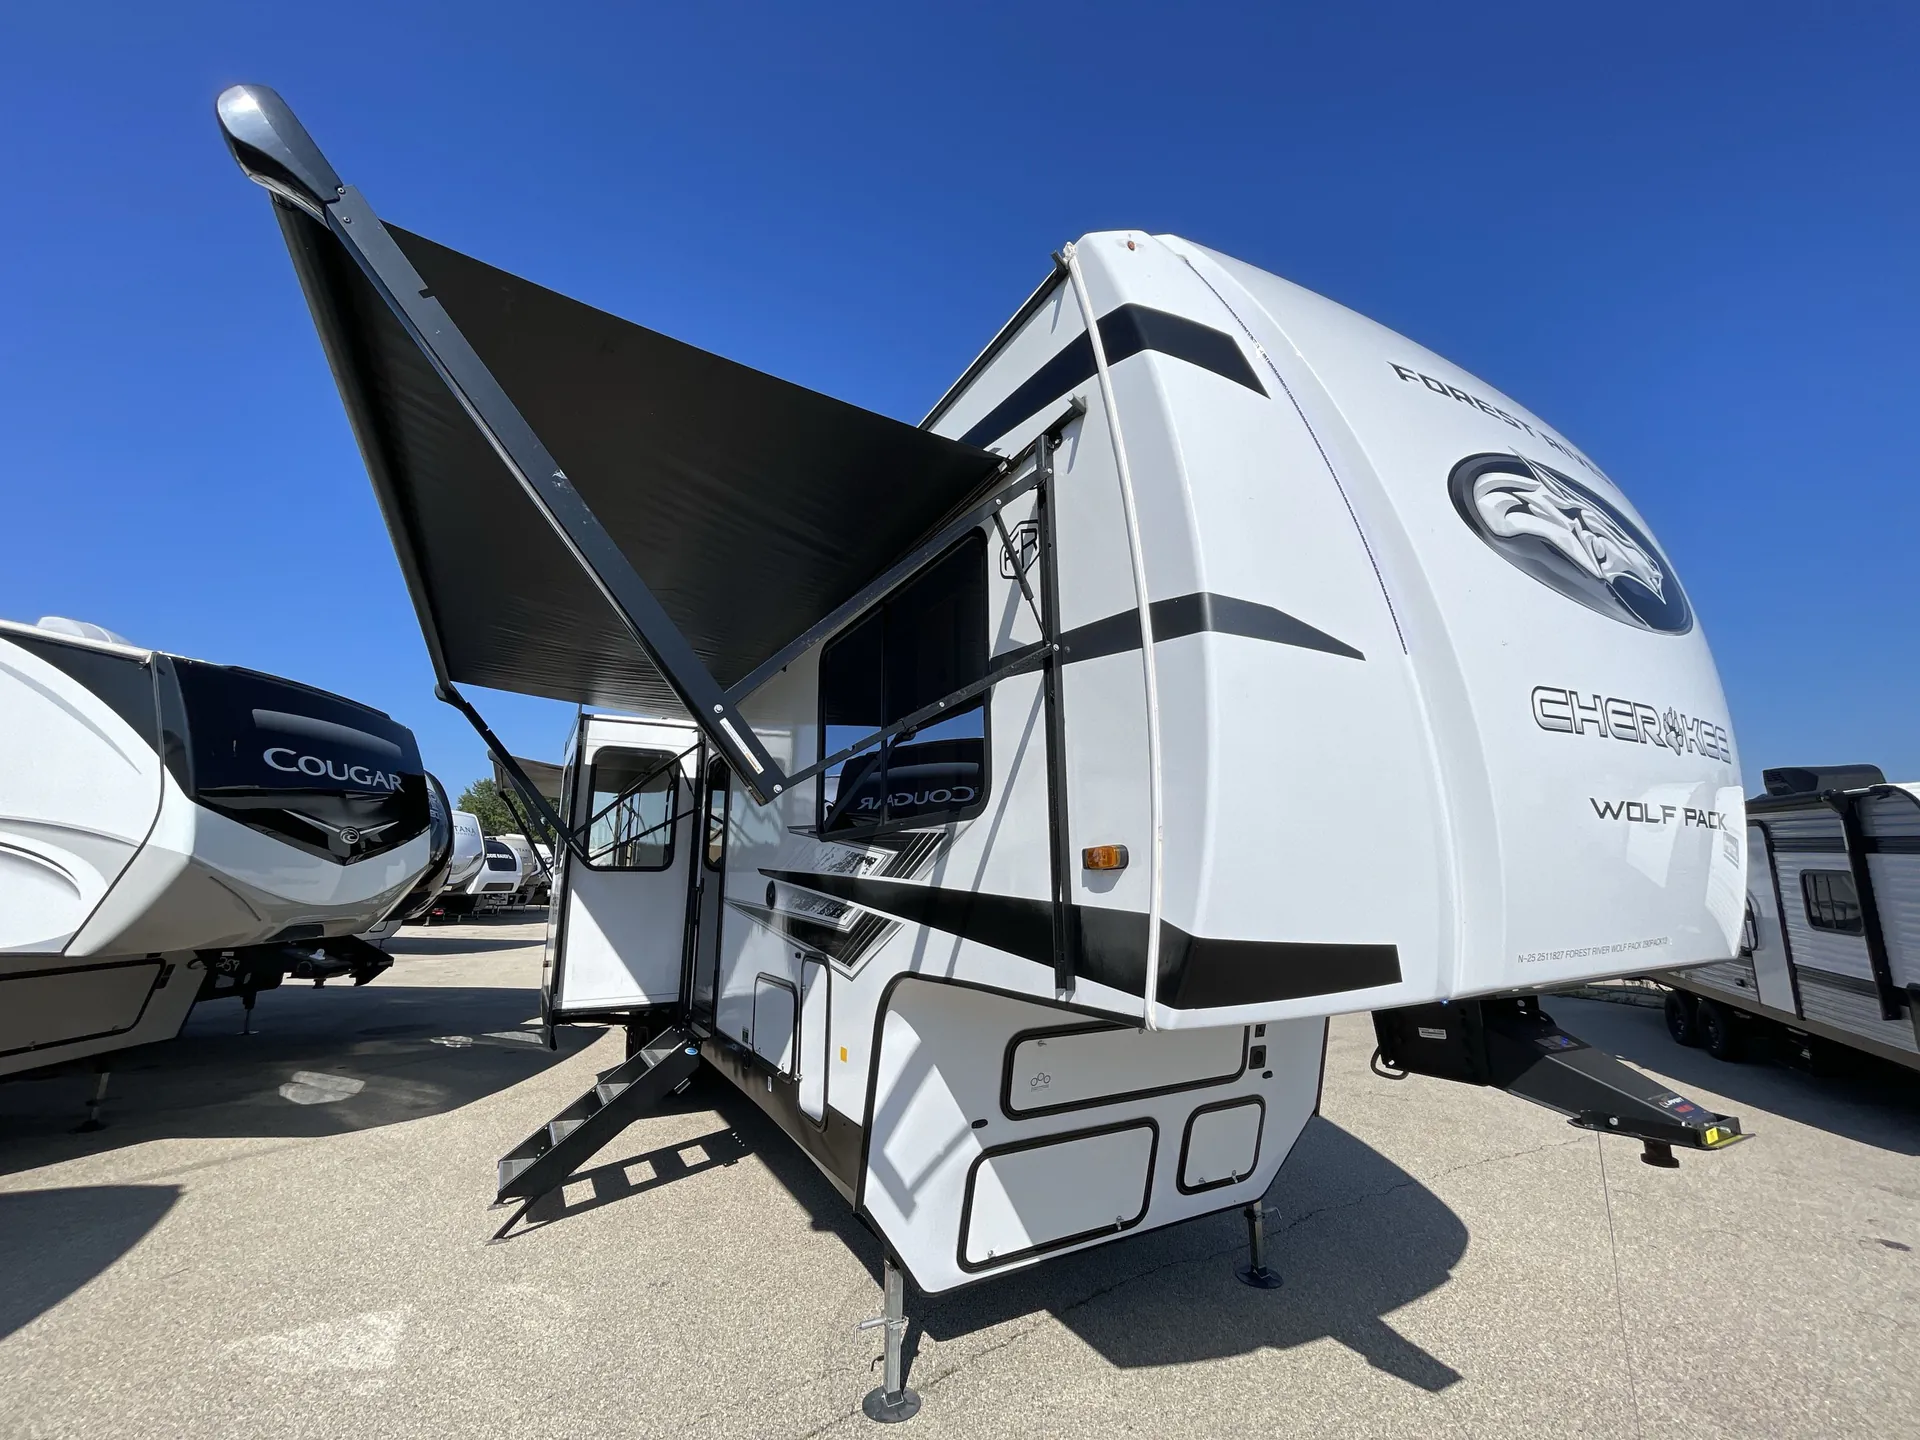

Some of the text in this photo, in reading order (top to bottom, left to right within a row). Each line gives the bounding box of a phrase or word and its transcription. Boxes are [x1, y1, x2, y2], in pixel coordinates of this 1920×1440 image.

[1386, 361, 1536, 437] FOREST
[263, 748, 405, 793] COUGAR
[1589, 797, 1728, 831] WOLF PACK
[1565, 947, 1591, 959] FOREST
[1592, 945, 1610, 956] RIVER
[1611, 942, 1628, 953] WOLF
[1628, 941, 1642, 951] PACK
